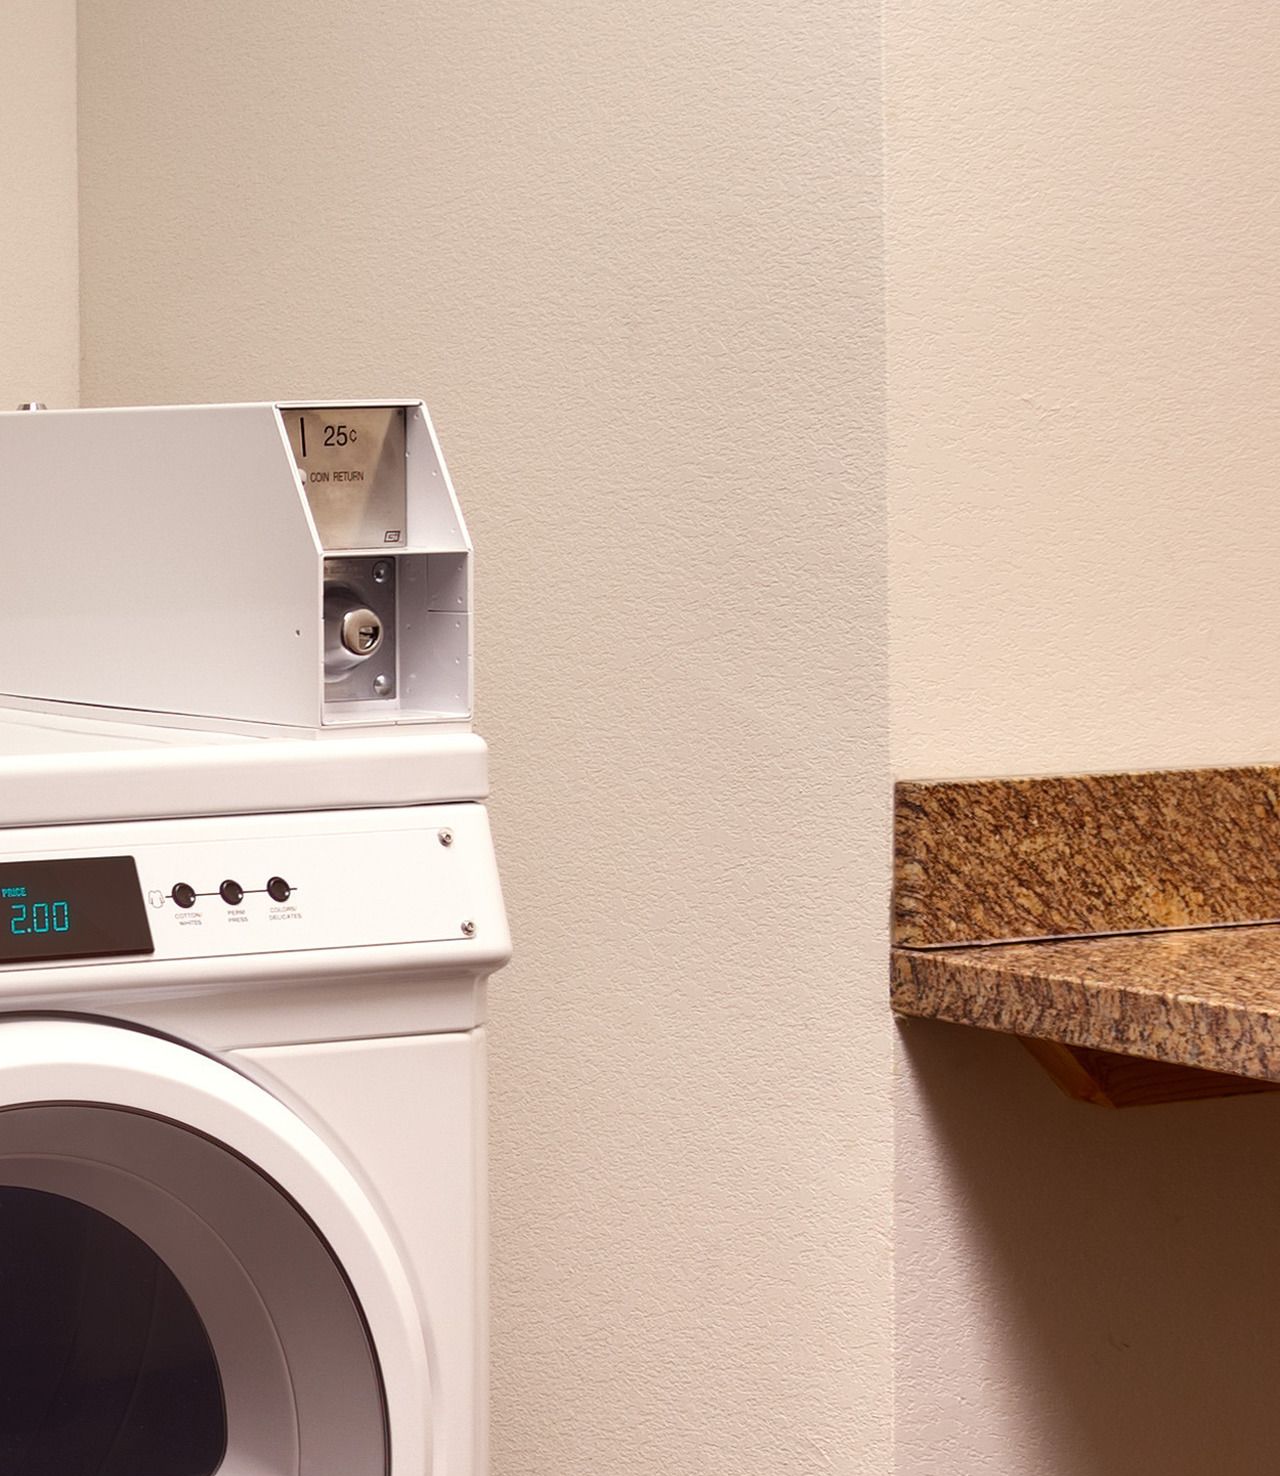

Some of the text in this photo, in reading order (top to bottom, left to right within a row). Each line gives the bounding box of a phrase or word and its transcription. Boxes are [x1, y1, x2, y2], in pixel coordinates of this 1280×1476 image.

[310, 471, 364, 483] COIN RETURN
[1, 887, 27, 898] PRICE
[10, 901, 70, 935] 2.00
